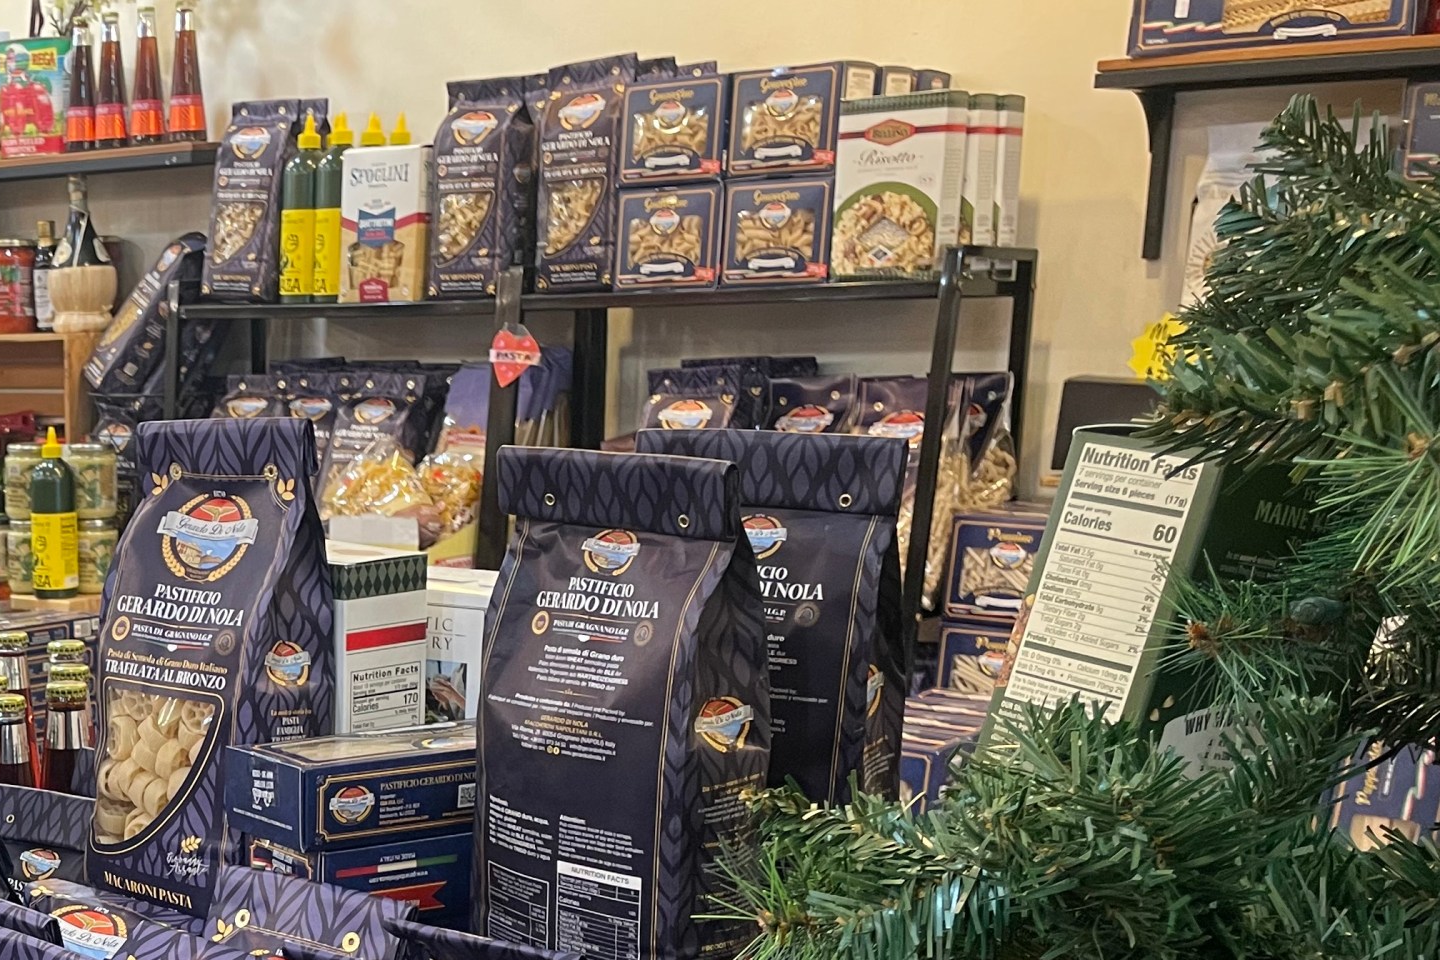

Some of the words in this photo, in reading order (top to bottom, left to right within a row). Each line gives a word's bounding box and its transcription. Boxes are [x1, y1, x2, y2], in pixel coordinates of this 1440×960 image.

[858, 149, 916, 166] Risotto
[350, 163, 410, 187] SFOGLINI
[496, 352, 532, 361] PASTA
[1082, 447, 1150, 472] Nutrition
[1084, 470, 1114, 483] servings
[1115, 475, 1126, 484] per
[1127, 477, 1162, 489] container
[1074, 479, 1102, 493] Serving
[1104, 484, 1120, 495] size
[1128, 488, 1155, 500] pieces
[1164, 494, 1188, 508] (17g)
[1254, 500, 1309, 530] MAINE
[1063, 511, 1112, 532] Calories
[1152, 524, 1177, 544] 60
[1071, 546, 1081, 555] Fat
[154, 583, 221, 605] PASTIFICIO
[568, 577, 634, 598] PASTIFICIO
[772, 582, 824, 602] NOLA
[117, 595, 188, 622] GERARDO
[188, 607, 206, 623] DI
[205, 609, 244, 627] NOLA
[536, 591, 600, 612] GERARDO
[600, 598, 622, 616] DI
[622, 601, 659, 618] NOLA
[105, 659, 161, 682] TRAFILATA
[175, 670, 226, 691] BRONZO
[353, 670, 392, 683] Nutrition
[395, 665, 419, 676] Facts
[352, 702, 379, 714] Calories
[403, 692, 418, 705] 170
[571, 867, 606, 880] NUTRITION
[607, 874, 630, 885] FACTS
[103, 871, 157, 899] MACARONI
[159, 888, 192, 909] PASTA
